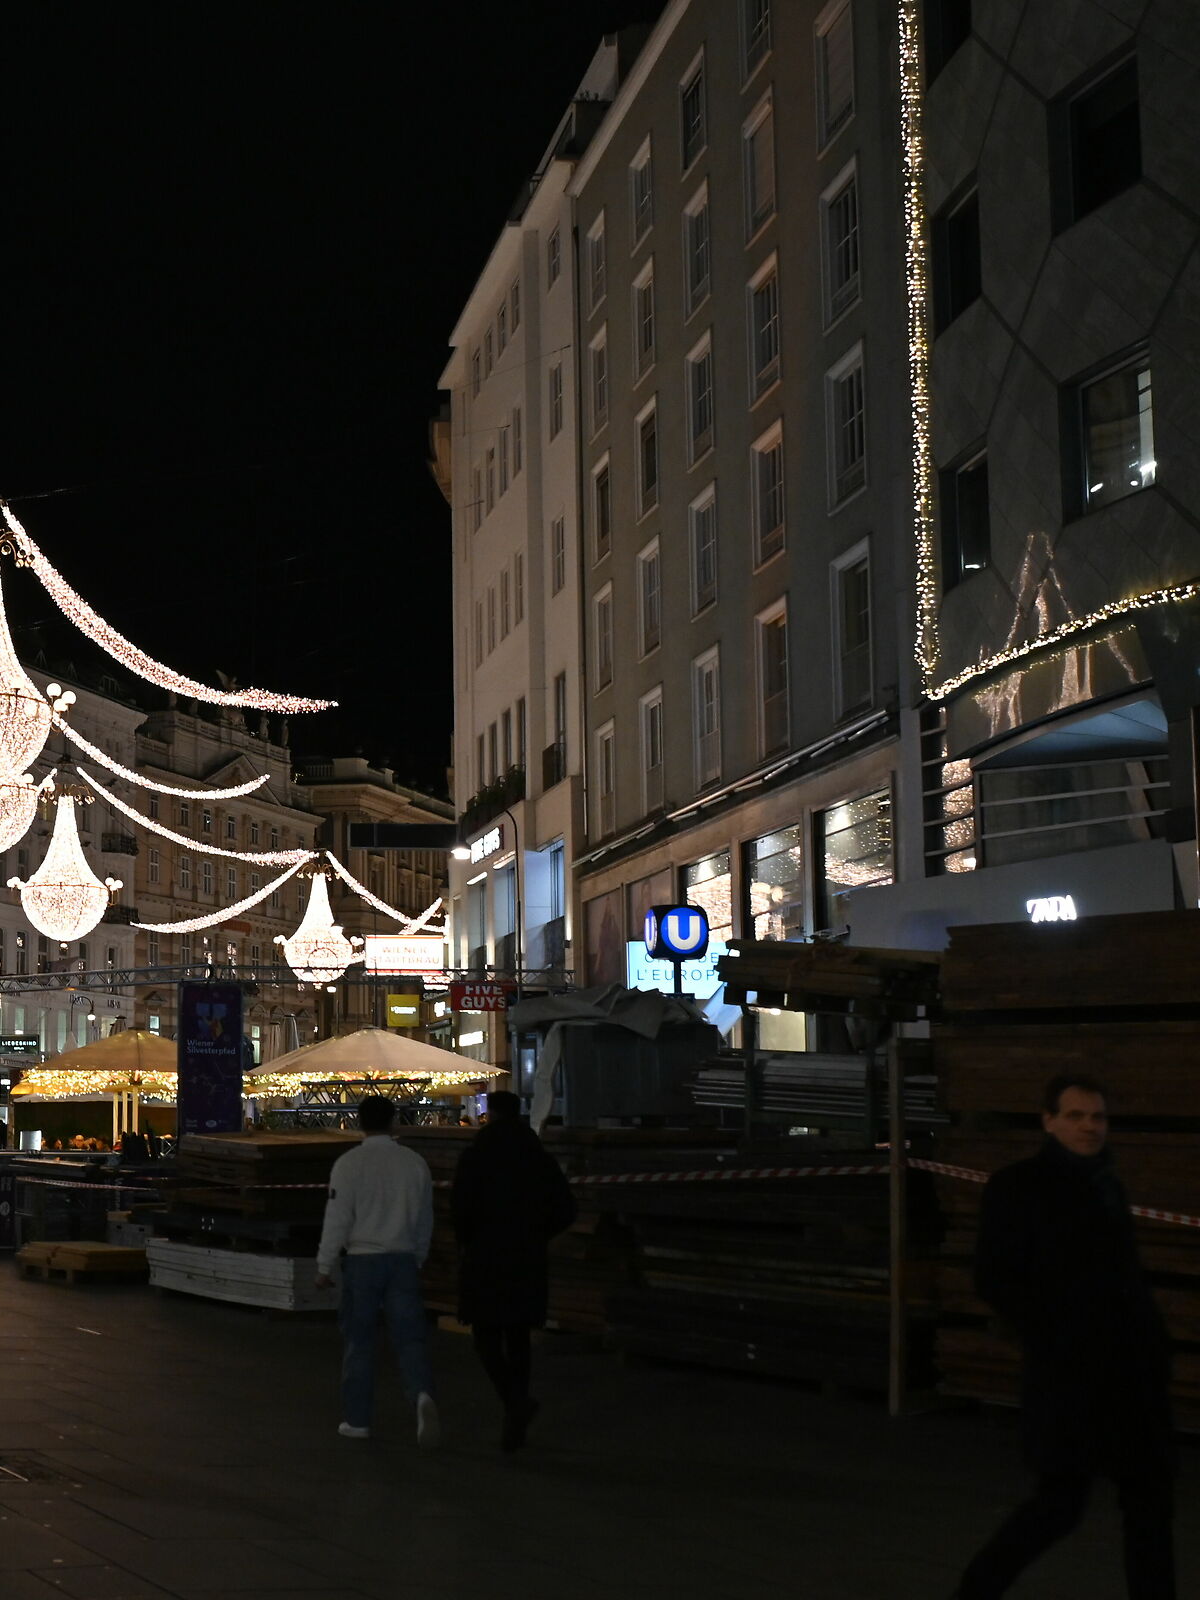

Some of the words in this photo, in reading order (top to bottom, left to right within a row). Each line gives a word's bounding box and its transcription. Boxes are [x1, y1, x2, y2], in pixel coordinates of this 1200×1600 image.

[668, 915, 700, 950] U
[636, 969, 715, 981] L'EUROP
[465, 985, 503, 995] FIVE
[461, 997, 506, 1009] GUYS
[187, 1039, 214, 1047] Wiener
[187, 1047, 236, 1055] Silvesterpfad
